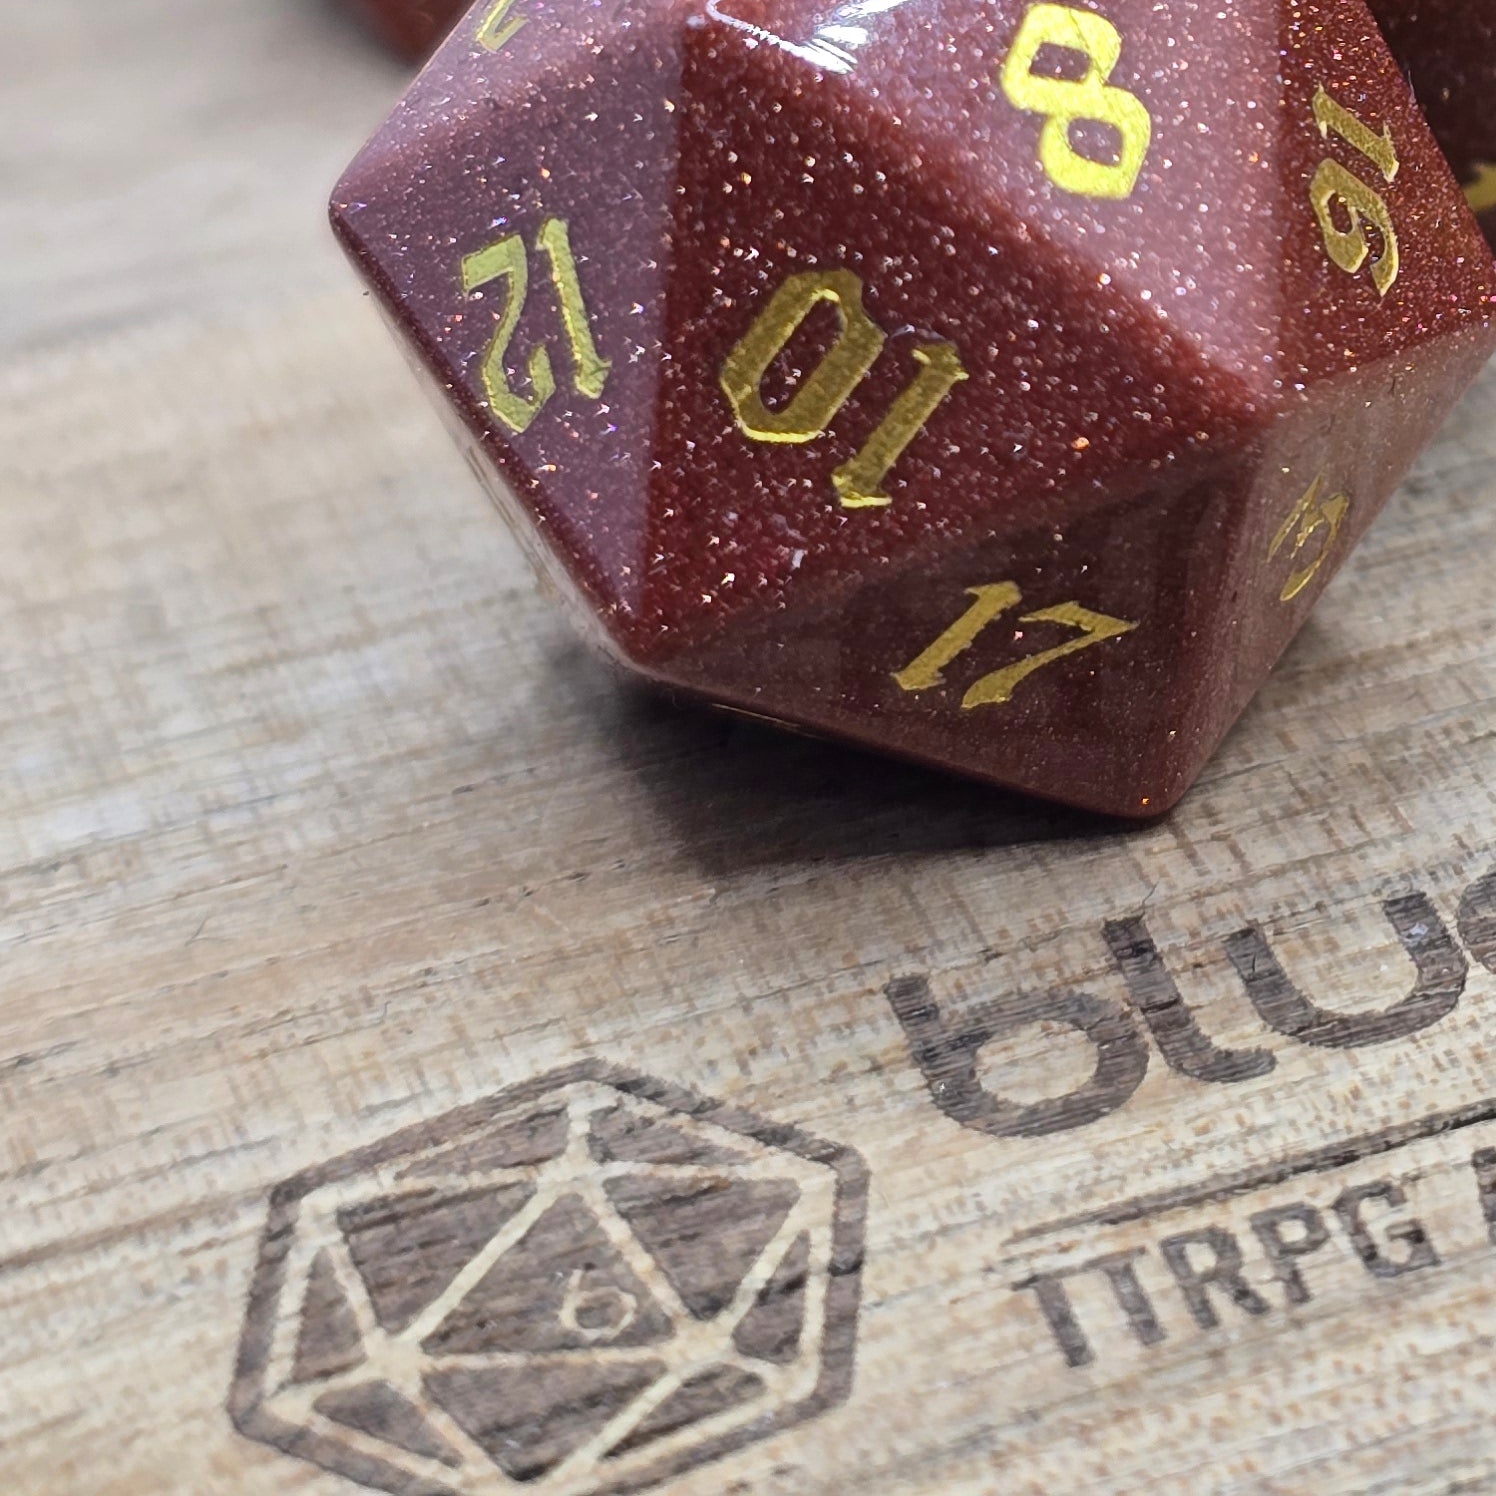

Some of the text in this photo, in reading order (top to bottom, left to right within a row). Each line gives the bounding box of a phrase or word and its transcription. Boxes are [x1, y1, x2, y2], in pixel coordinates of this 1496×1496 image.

[1000, 1, 1152, 201] 8
[1308, 80, 1402, 298] 16
[460, 216, 612, 436] 12
[718, 267, 970, 510] 10
[889, 581, 1138, 710] 17
[1010, 1180, 1440, 1370] TTRPG
